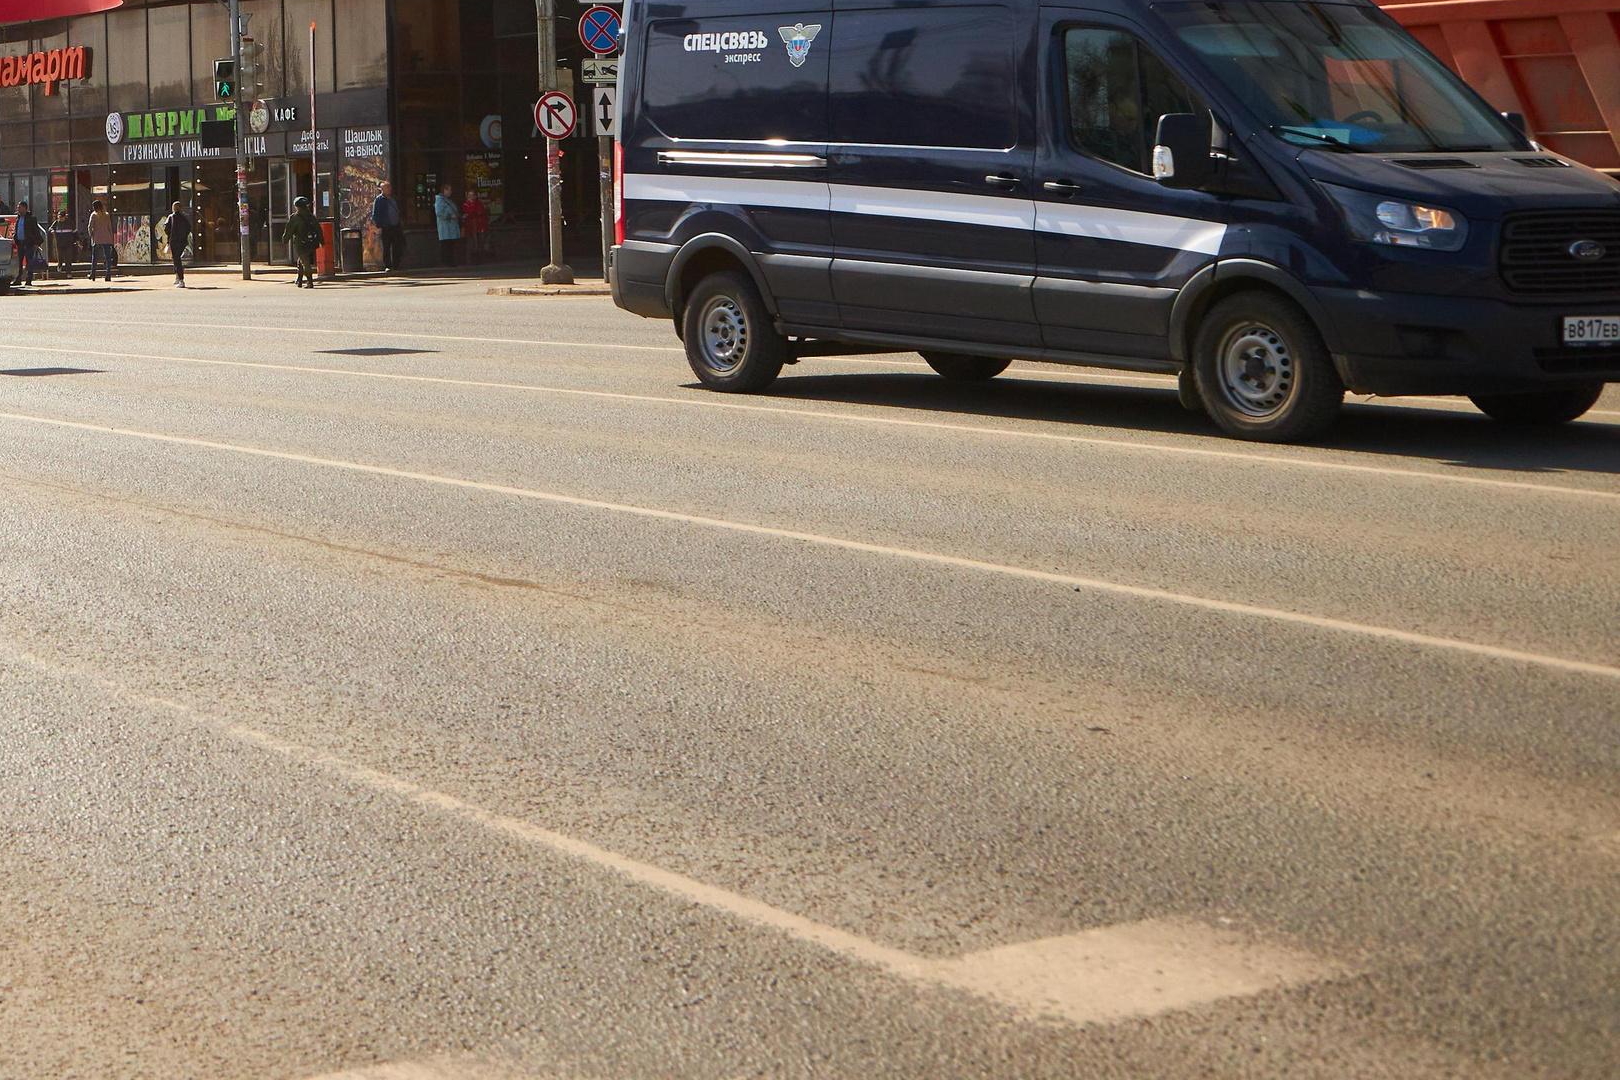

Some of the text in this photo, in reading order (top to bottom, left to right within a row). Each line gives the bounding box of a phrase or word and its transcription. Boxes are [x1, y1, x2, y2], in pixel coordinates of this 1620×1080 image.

[683, 31, 768, 53] СПЕЦСВЯЗЬ
[724, 53, 761, 65] экспресс
[274, 107, 296, 122] КАФЕ
[301, 130, 321, 143] Добо
[344, 129, 383, 144] Шашлык
[123, 142, 174, 161] ГРУЗИНСКИЕ
